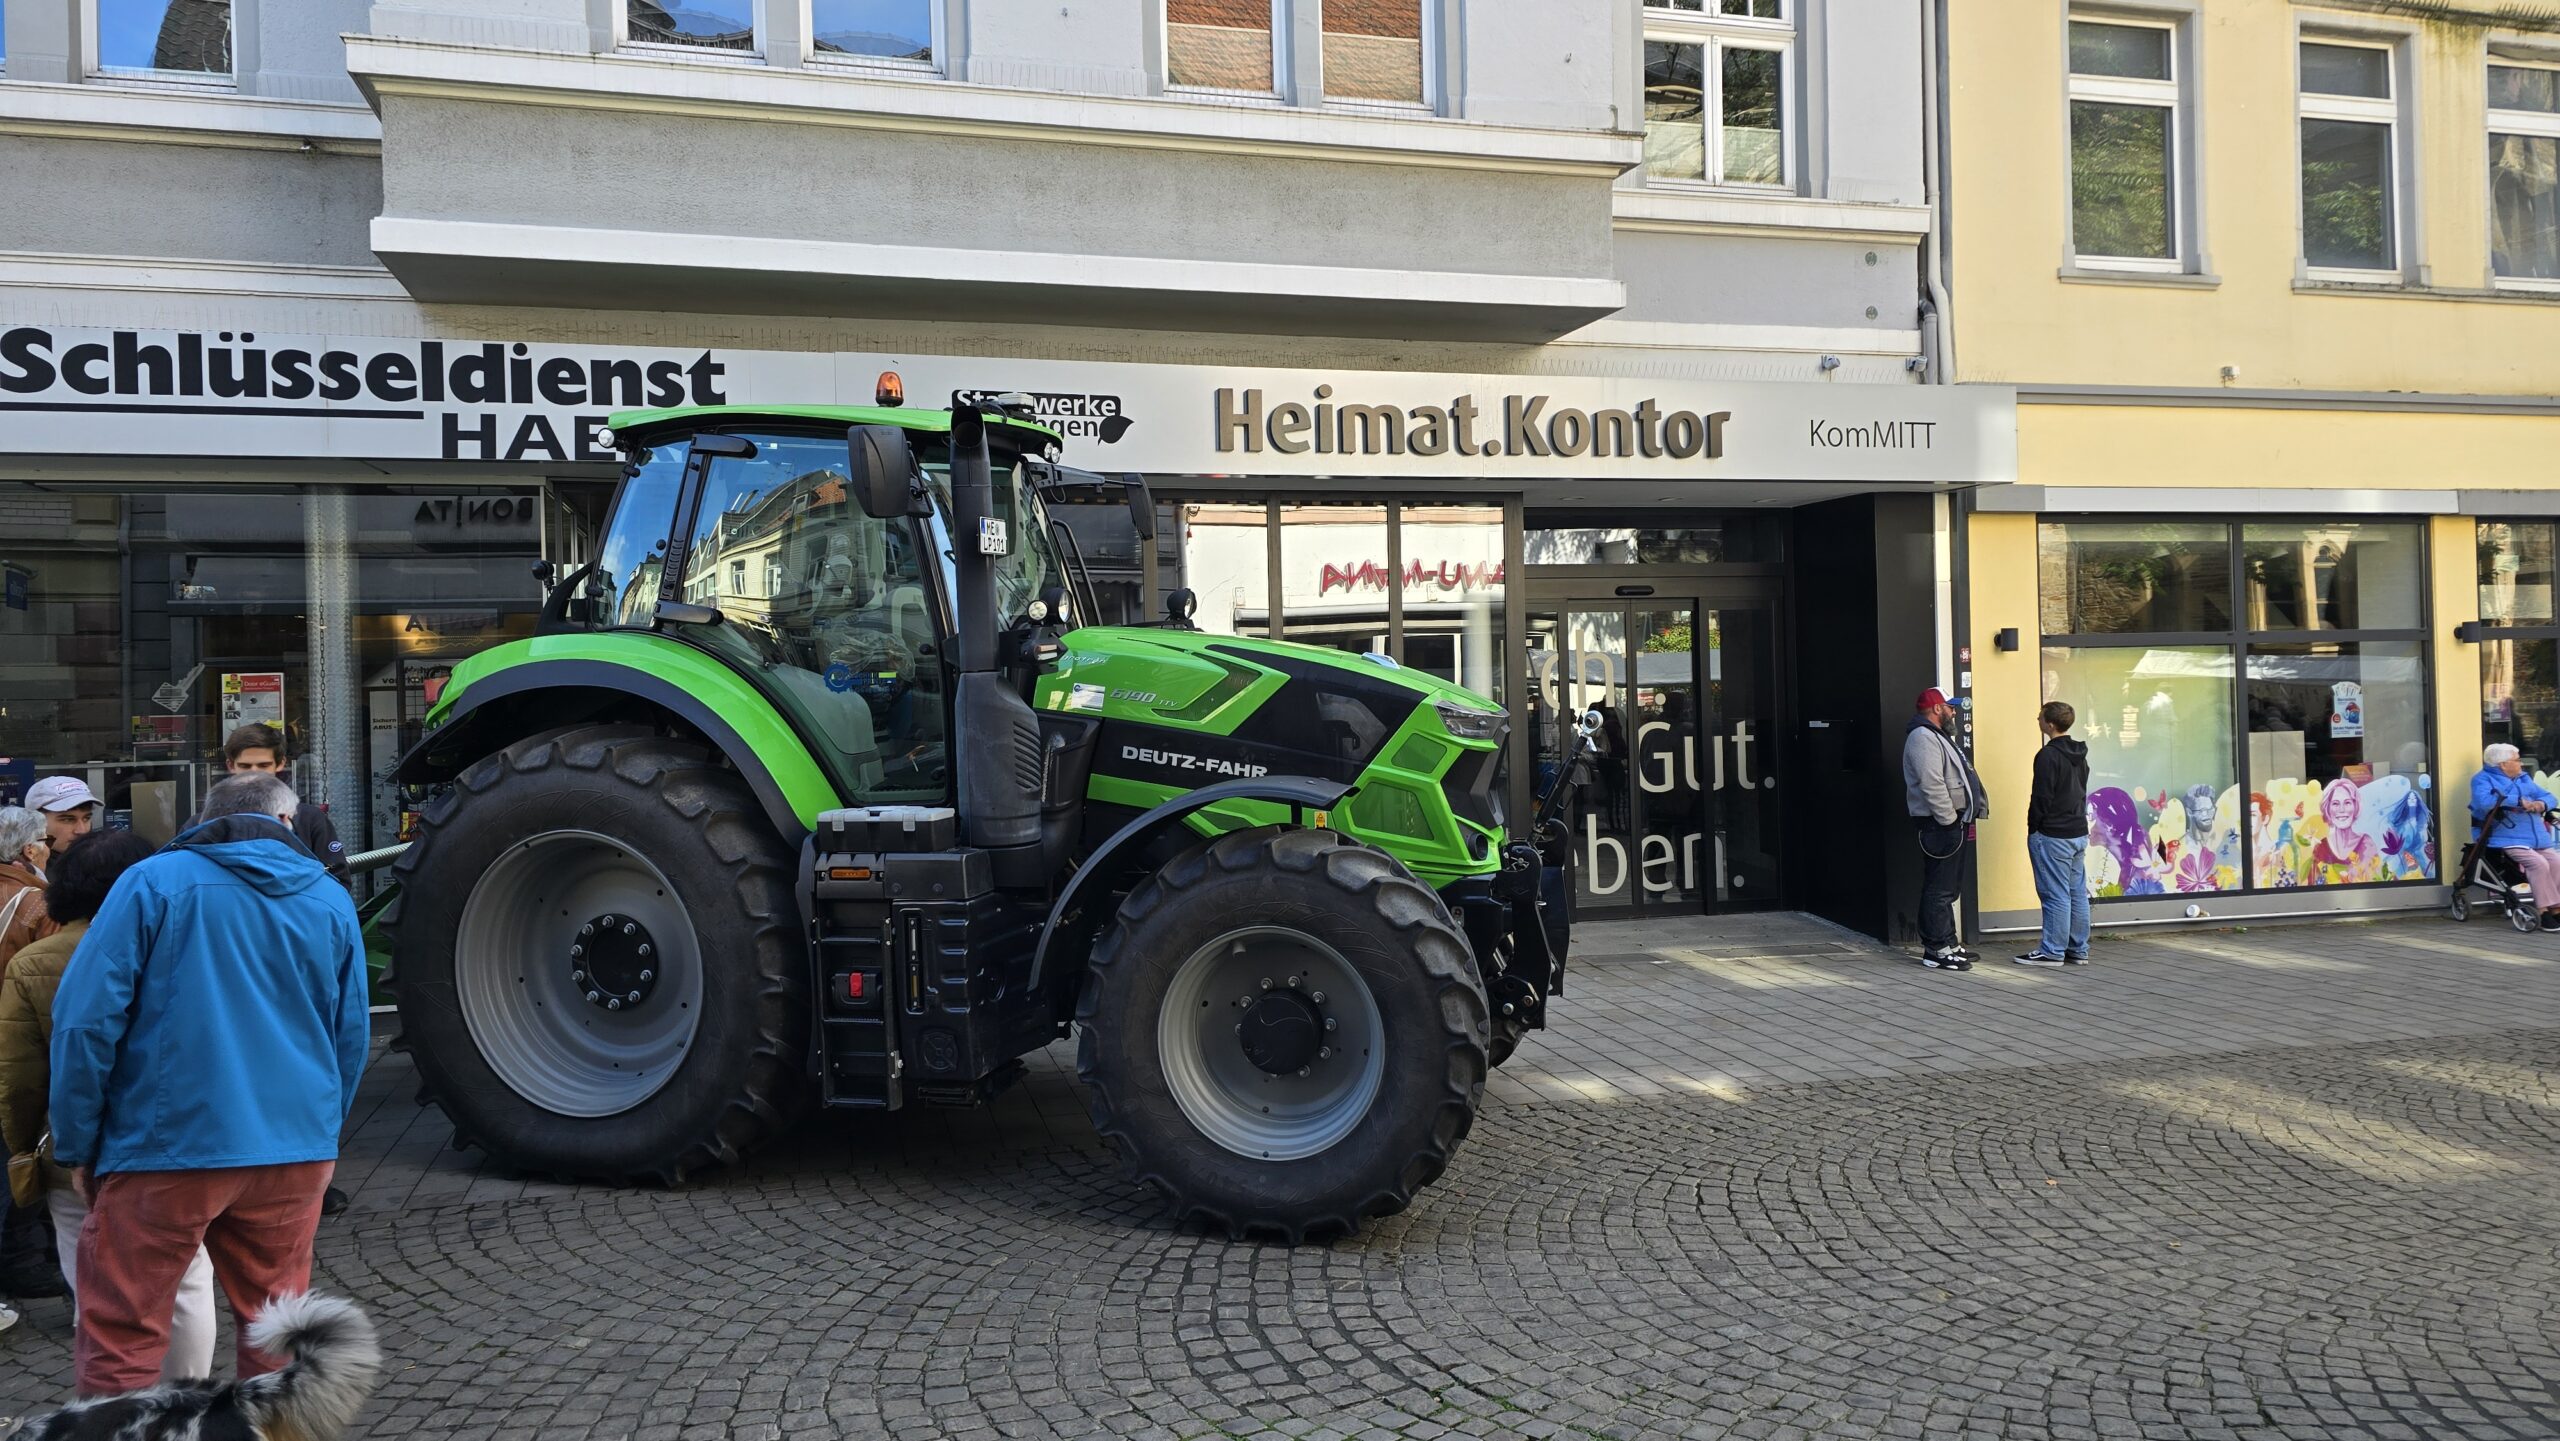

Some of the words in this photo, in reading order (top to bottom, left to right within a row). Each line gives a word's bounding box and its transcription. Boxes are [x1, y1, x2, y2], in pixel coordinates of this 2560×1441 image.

[0, 327, 727, 408] Schlüsseldienst
[1214, 383, 1732, 459] Heimat.Kontor
[1810, 419, 1937, 449] KomMITT
[1121, 745, 1269, 778] DEUTZ-FAHR
